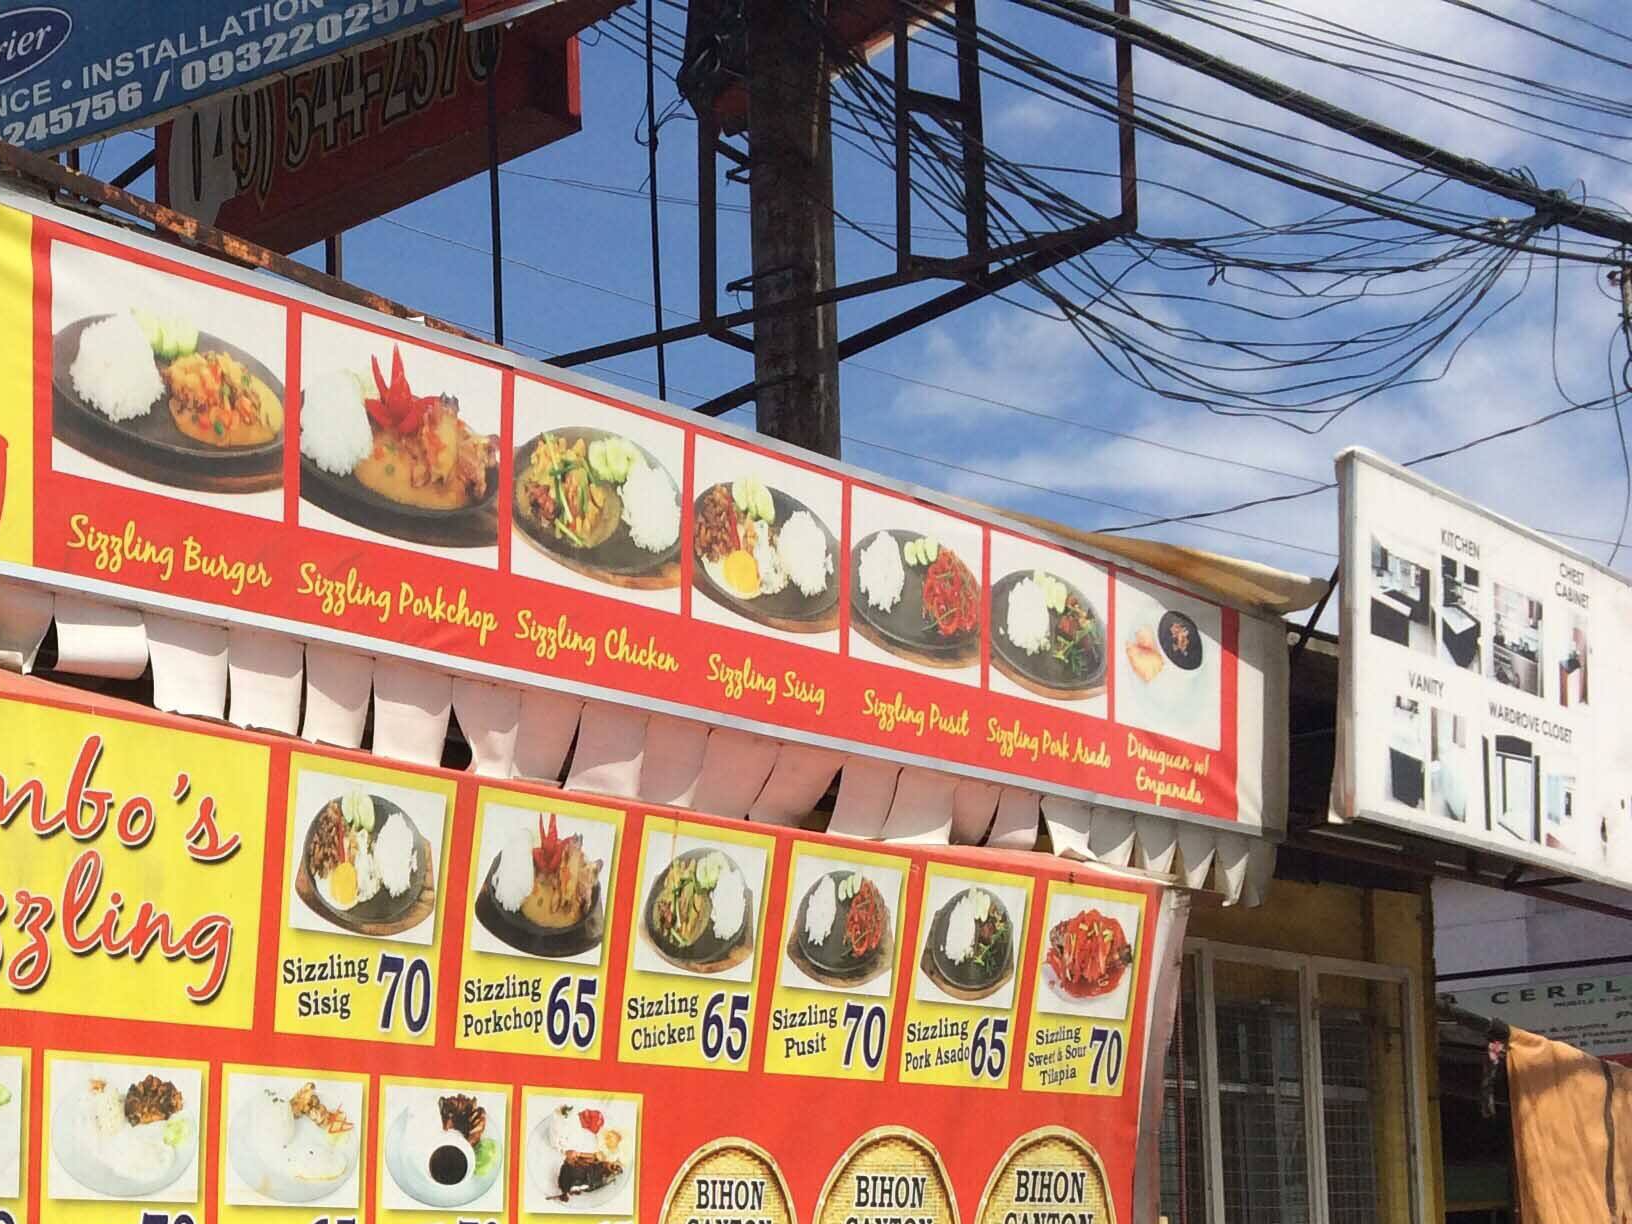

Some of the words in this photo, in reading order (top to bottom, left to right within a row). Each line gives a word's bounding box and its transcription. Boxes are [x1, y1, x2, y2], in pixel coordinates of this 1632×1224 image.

[66, 514, 174, 581] Sizzling
[183, 536, 273, 595] Burger
[1440, 528, 1480, 560] KITCHEN
[1559, 562, 1585, 586] CHEST
[297, 562, 392, 623] Sizzling
[398, 582, 498, 647] Porkchop
[1554, 581, 1590, 608] CABINET
[514, 609, 596, 667] Sizzling
[604, 628, 680, 673] Chicken
[706, 653, 777, 705] Sizzling
[782, 670, 826, 715] Sisig
[1408, 671, 1445, 697] VANITY
[862, 689, 925, 737] Sizzling
[929, 703, 970, 737] Pusit
[1488, 702, 1541, 733] WARDROVE
[1541, 720, 1573, 744] CLOSET
[986, 717, 1040, 762] Sizzling
[1042, 730, 1070, 760] Pork
[1072, 742, 1112, 769] Asado
[1127, 732, 1192, 775] Dinuguan
[1135, 766, 1205, 806] Empanada
[282, 953, 369, 985] Sizzling
[298, 988, 351, 1020] Sisig
[376, 952, 431, 1033] 70
[464, 974, 542, 1003] Sizzling
[463, 1006, 543, 1037] Porkchop
[547, 976, 598, 1048] 65
[627, 992, 699, 1020] Sizzling
[772, 1003, 838, 1030] Sizzling
[631, 1023, 696, 1051] Chicken
[701, 993, 750, 1060] 65
[843, 1002, 886, 1068] 70
[906, 1018, 970, 1042] Sizzling
[784, 1032, 827, 1058] Pusit
[905, 1051, 931, 1072] Pork
[934, 1044, 970, 1065] Asado
[970, 1017, 1009, 1079] 65
[1028, 1050, 1056, 1067] Sweet
[1064, 1044, 1087, 1060] Sour
[1089, 1026, 1122, 1085] 70
[1039, 1064, 1077, 1086] Tilapia
[695, 1178, 765, 1211] BIHON
[855, 1175, 927, 1209] BIHON
[1014, 1170, 1086, 1203] BIHON
